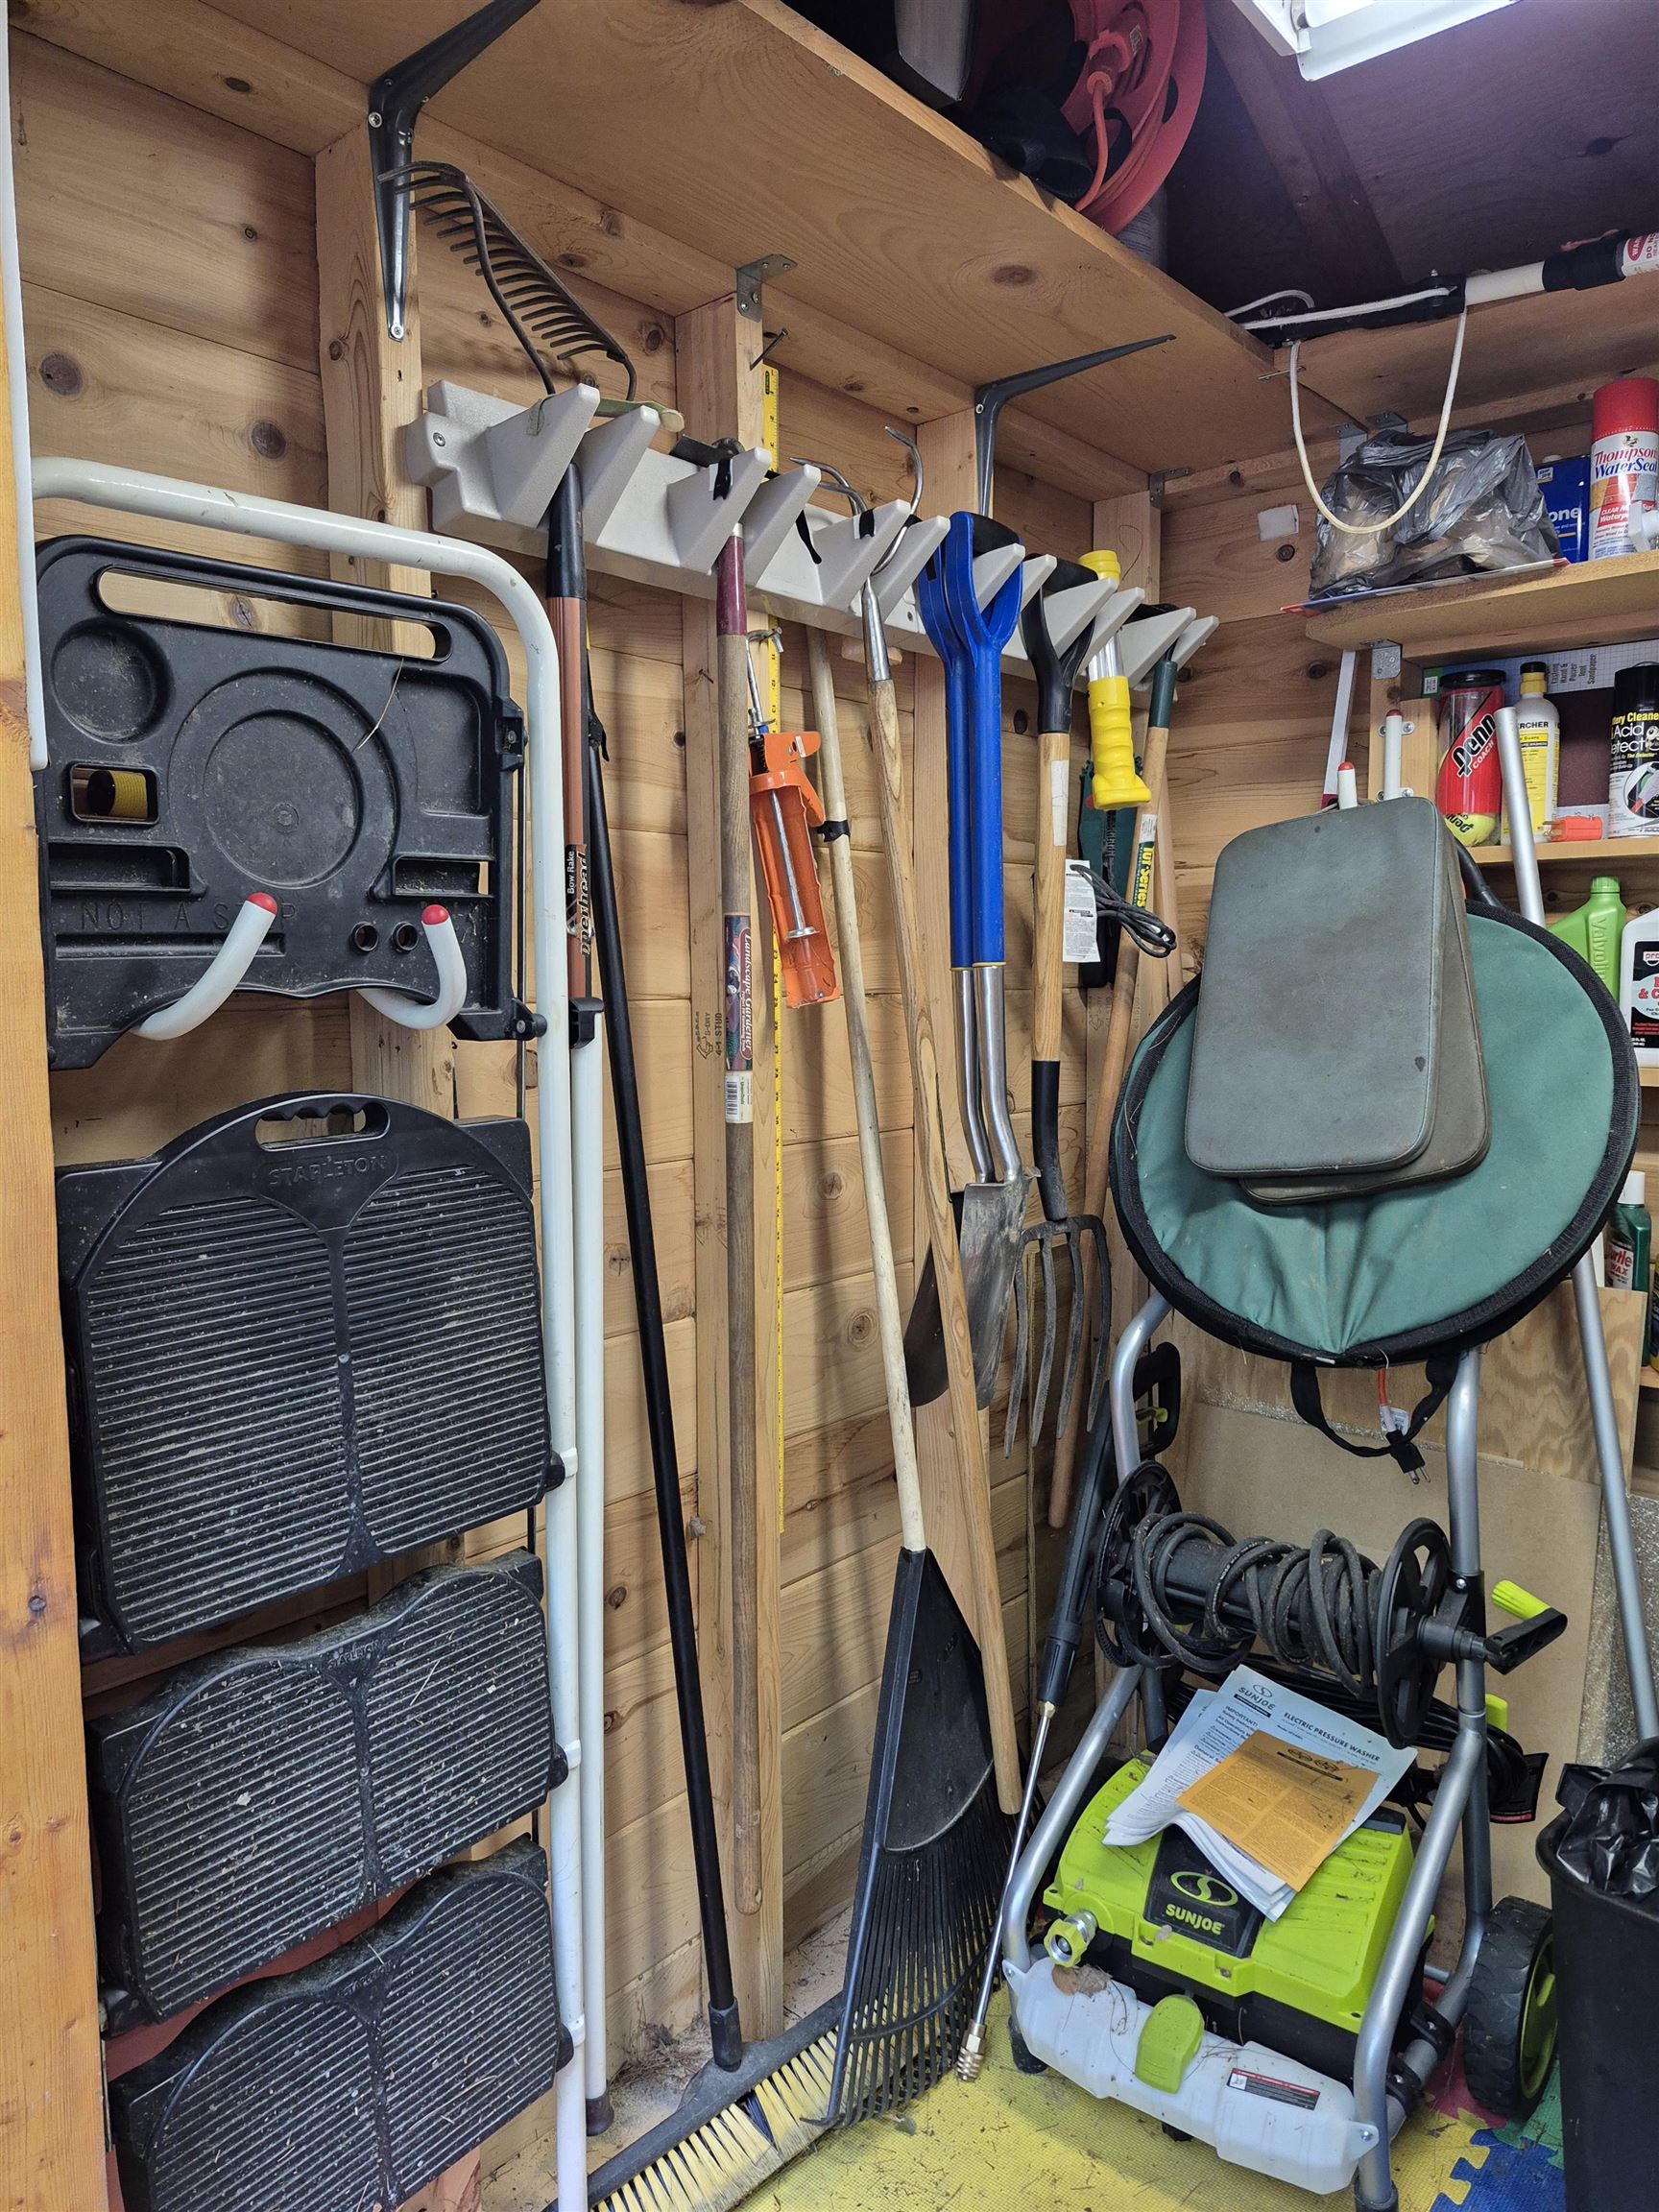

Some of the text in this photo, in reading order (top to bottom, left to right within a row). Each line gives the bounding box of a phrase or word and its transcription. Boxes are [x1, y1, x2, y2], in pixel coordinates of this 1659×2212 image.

[1614, 721, 1645, 738] Acid
[1473, 740, 1495, 769] COACH
[566, 851, 575, 873] Rake
[81, 901, 298, 931] NOT A SP
[268, 1155, 385, 1187] STAPLETON
[1238, 1686, 1276, 1711] SUNJOE
[1284, 1712, 1314, 1732] ELECTRIC
[1313, 1727, 1349, 1748] PRESSURE
[1348, 1744, 1381, 1763] WASHER
[1165, 1903, 1223, 1936] SUNJOE
